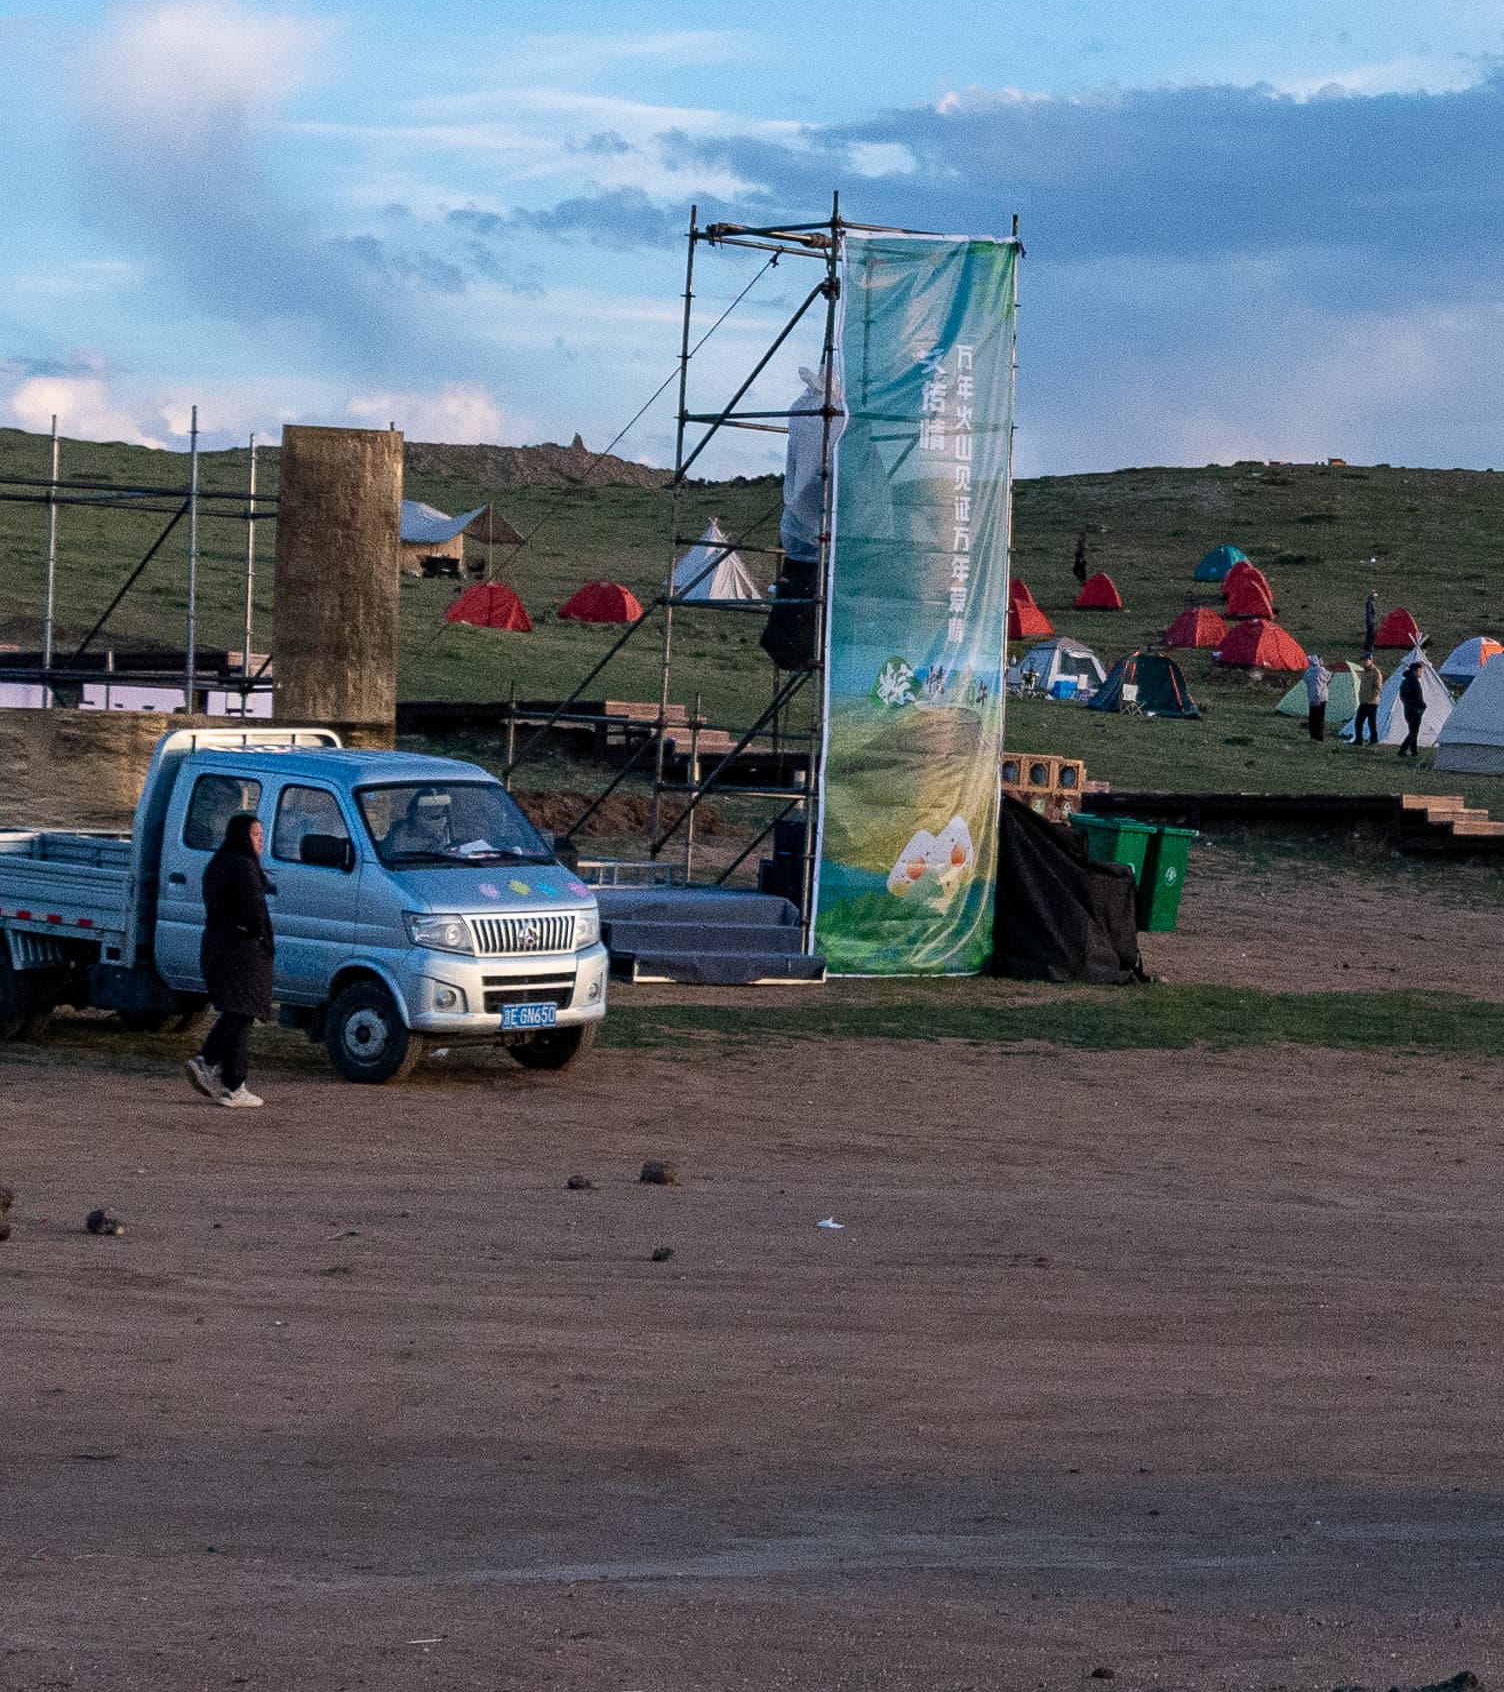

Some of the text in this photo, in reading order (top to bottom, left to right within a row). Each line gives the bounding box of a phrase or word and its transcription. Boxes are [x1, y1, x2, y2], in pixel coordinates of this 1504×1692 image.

[948, 344, 974, 644] 万年火山见证万年爱情
